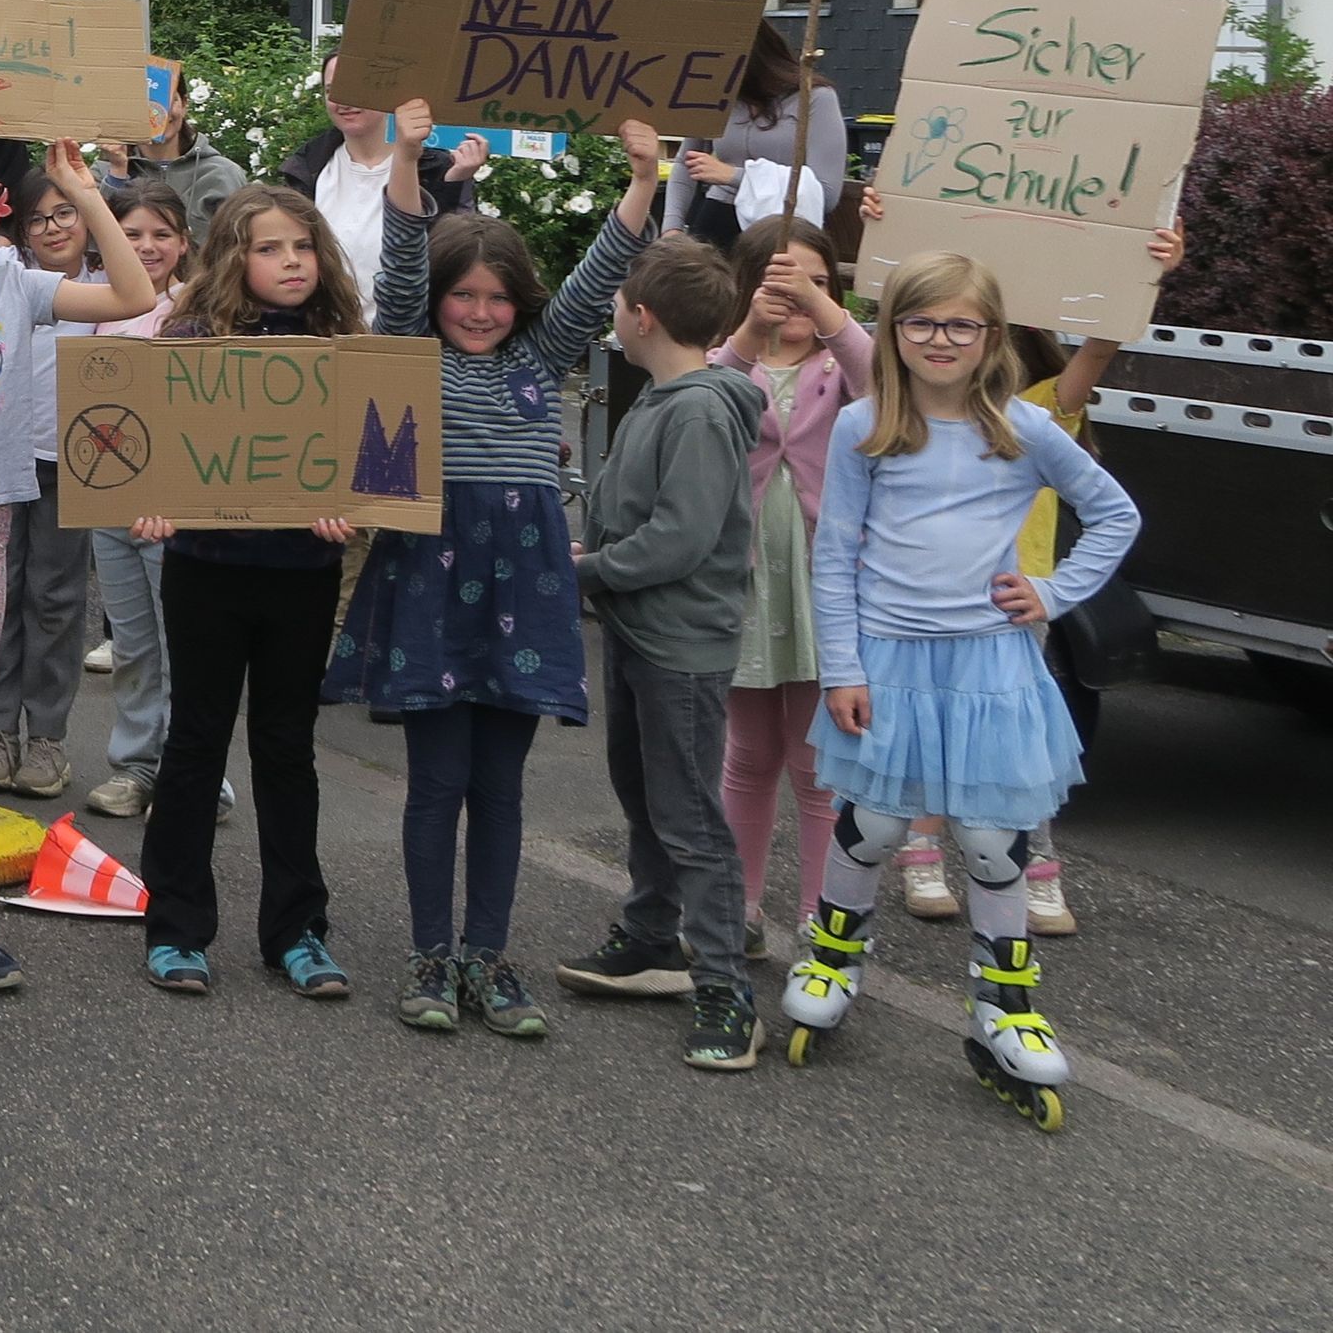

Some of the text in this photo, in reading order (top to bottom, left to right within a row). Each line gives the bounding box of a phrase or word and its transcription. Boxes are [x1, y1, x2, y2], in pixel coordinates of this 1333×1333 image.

[454, 34, 748, 112] DANKE!
[959, 7, 1146, 85] Sicher
[1004, 100, 1075, 141] zur
[940, 141, 1141, 216] Schule!
[165, 346, 330, 411] AUTOS
[181, 432, 339, 492] WEG
